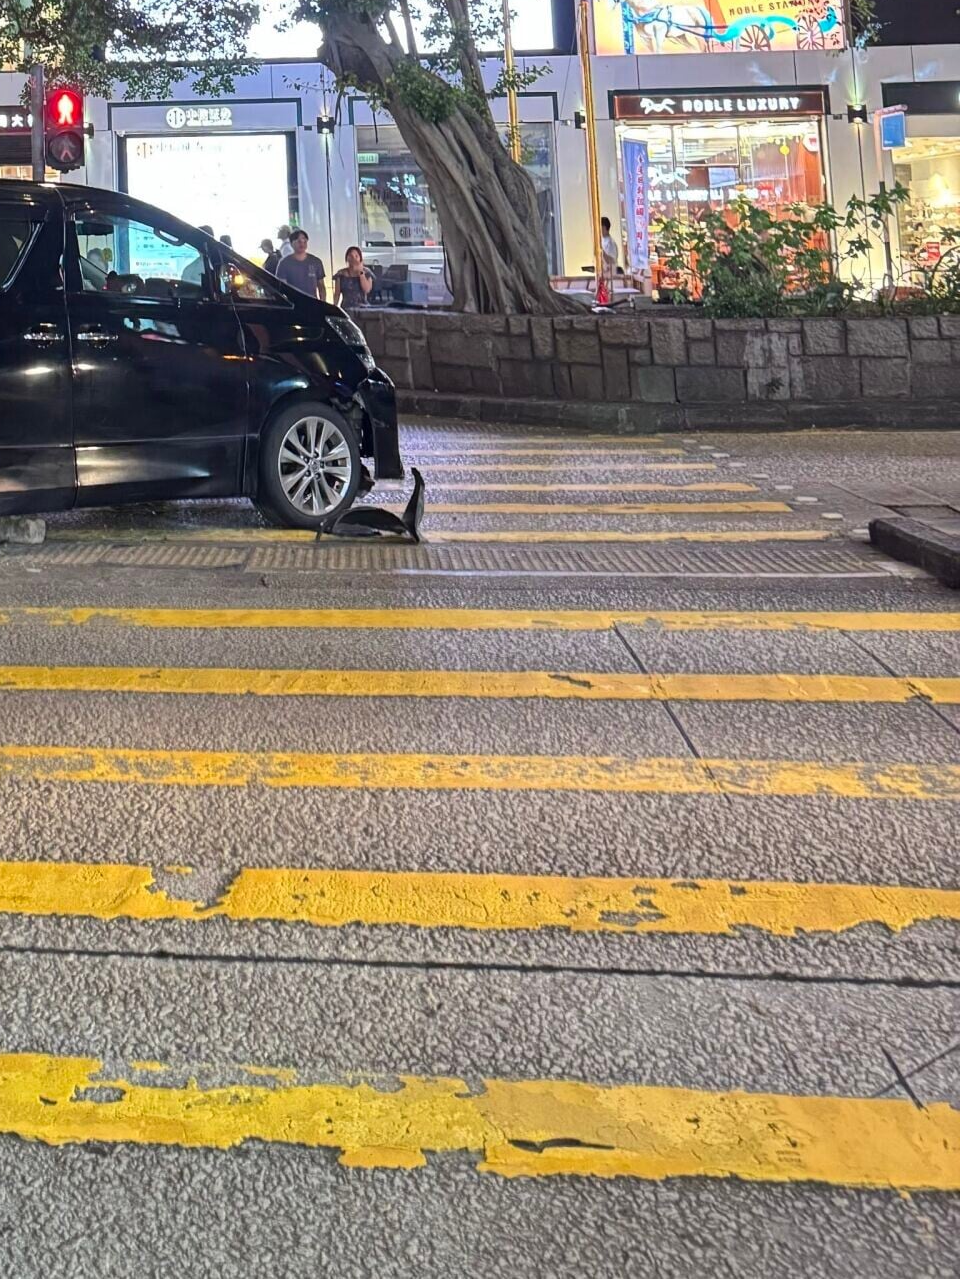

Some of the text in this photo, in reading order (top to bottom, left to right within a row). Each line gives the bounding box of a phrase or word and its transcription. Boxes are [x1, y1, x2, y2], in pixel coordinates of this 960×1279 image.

[729, 3, 763, 16] NOBLE
[682, 97, 800, 112] NOBLE LUXURY
